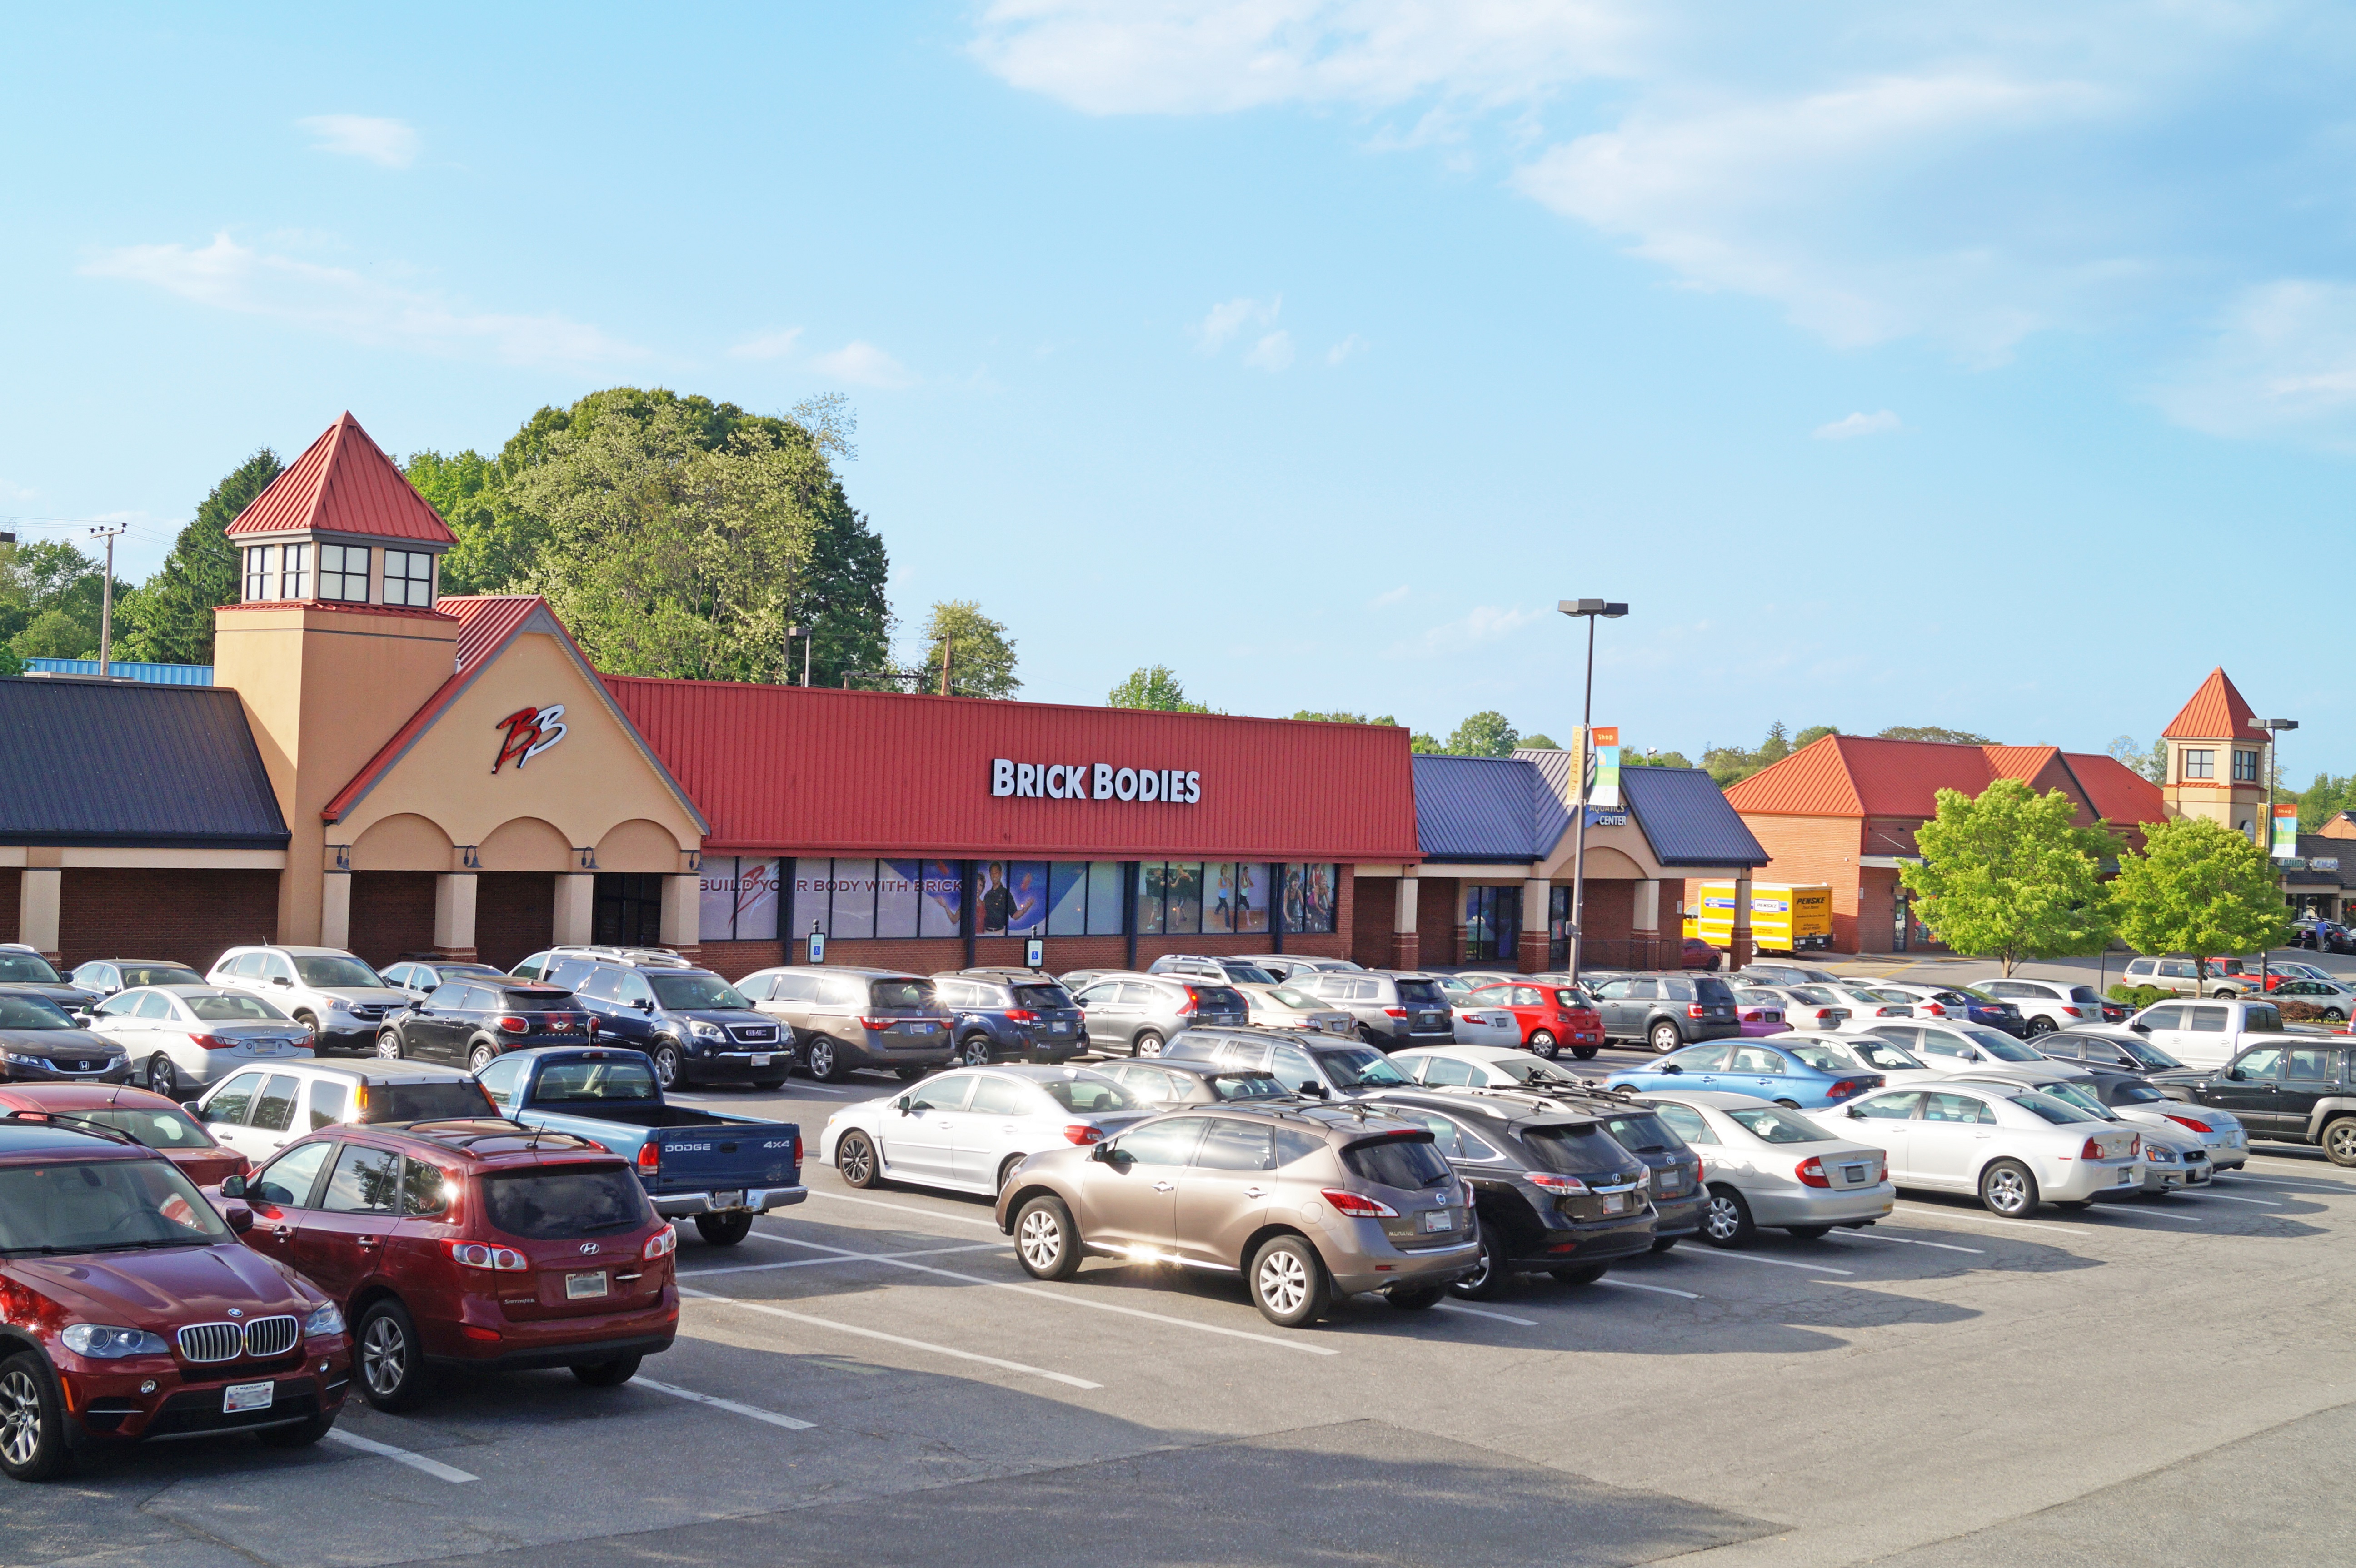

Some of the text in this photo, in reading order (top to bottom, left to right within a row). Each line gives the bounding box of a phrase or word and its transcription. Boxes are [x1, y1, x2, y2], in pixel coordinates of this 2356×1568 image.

[1569, 731, 1581, 800] Chartley Park
[991, 758, 1201, 804] BRICK BODIES
[1599, 815, 1627, 826] CENTER
[700, 879, 962, 892] BUILD YOR BODY WITH BRICK
[664, 1143, 711, 1152] DODGE
